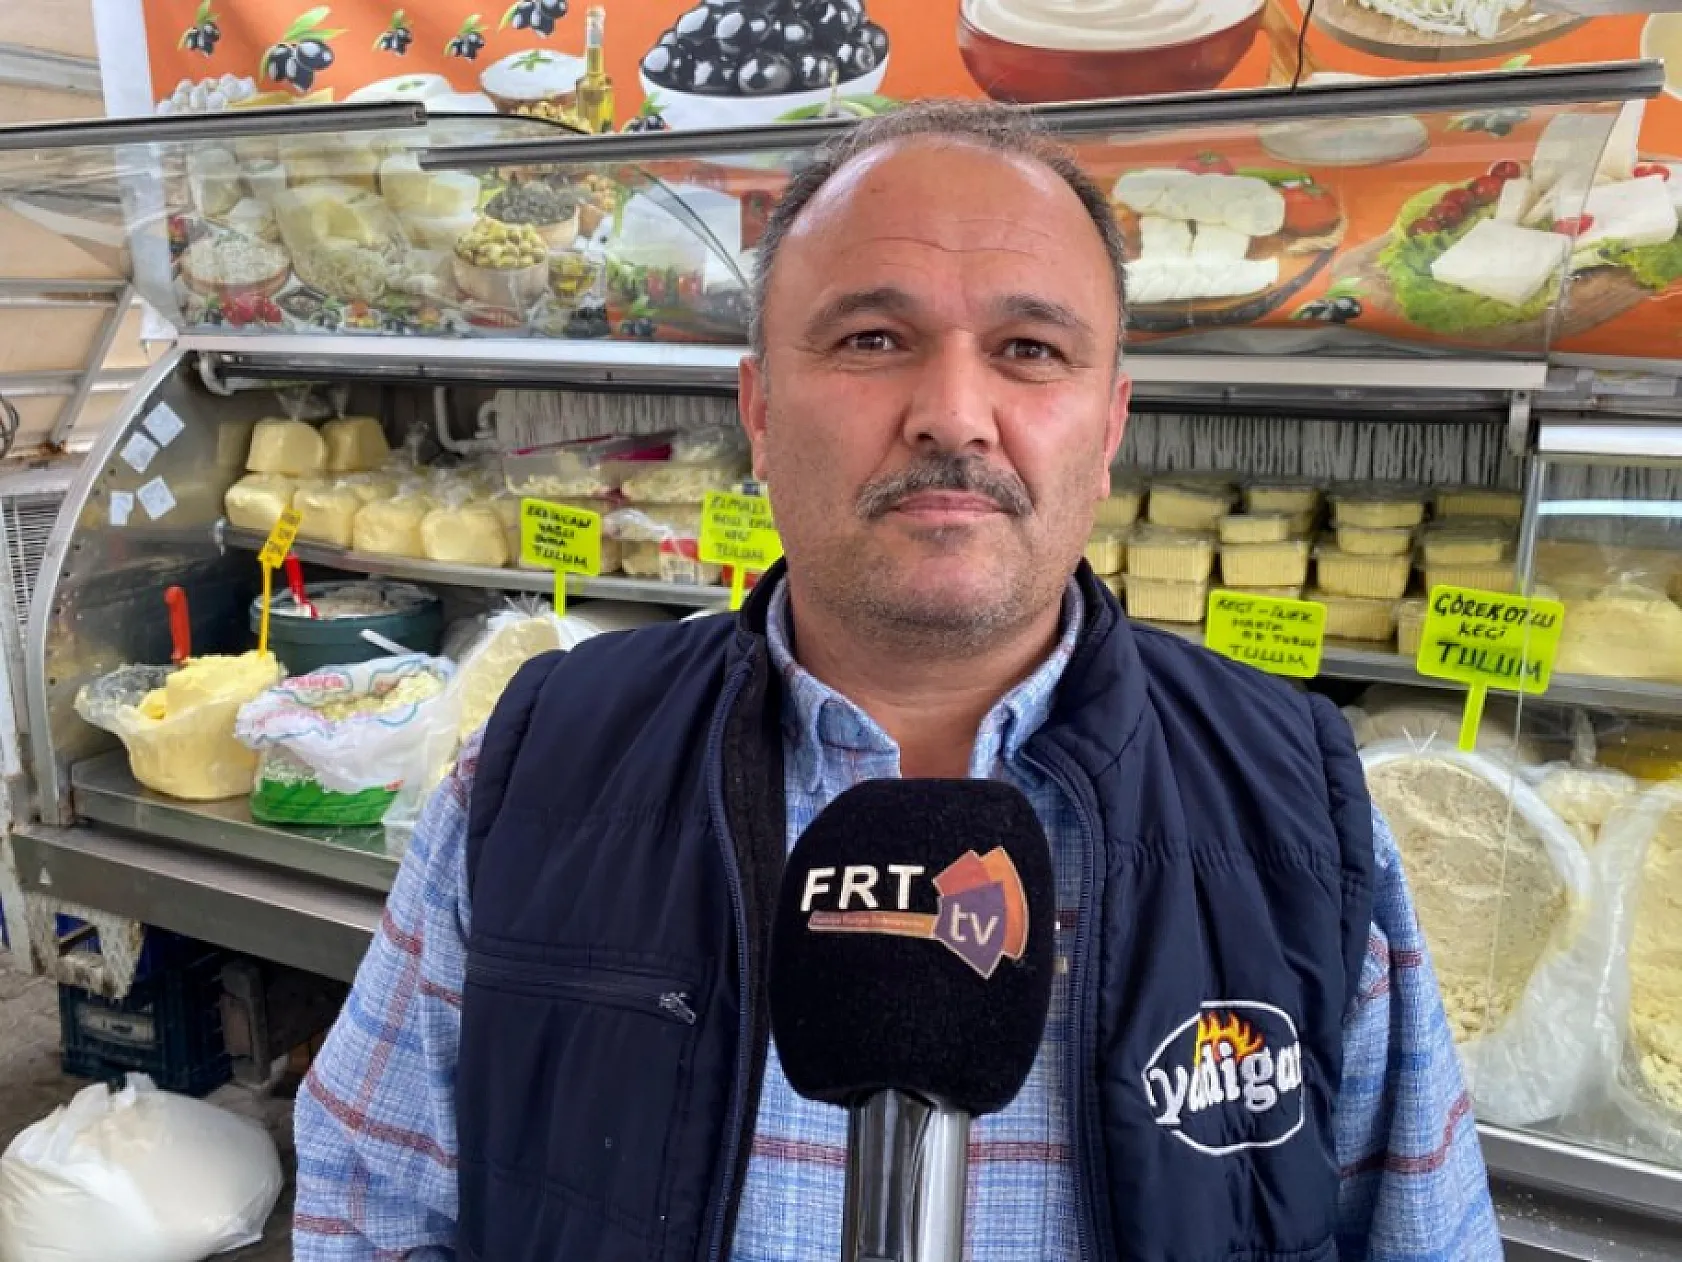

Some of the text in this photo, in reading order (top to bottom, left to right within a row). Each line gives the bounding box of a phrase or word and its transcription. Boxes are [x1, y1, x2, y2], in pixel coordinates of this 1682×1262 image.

[532, 544, 588, 570] TULUM
[1228, 643, 1309, 671] TULUM
[1436, 640, 1542, 684] TULUM
[800, 863, 926, 912] FRT
[950, 902, 999, 945] tv
